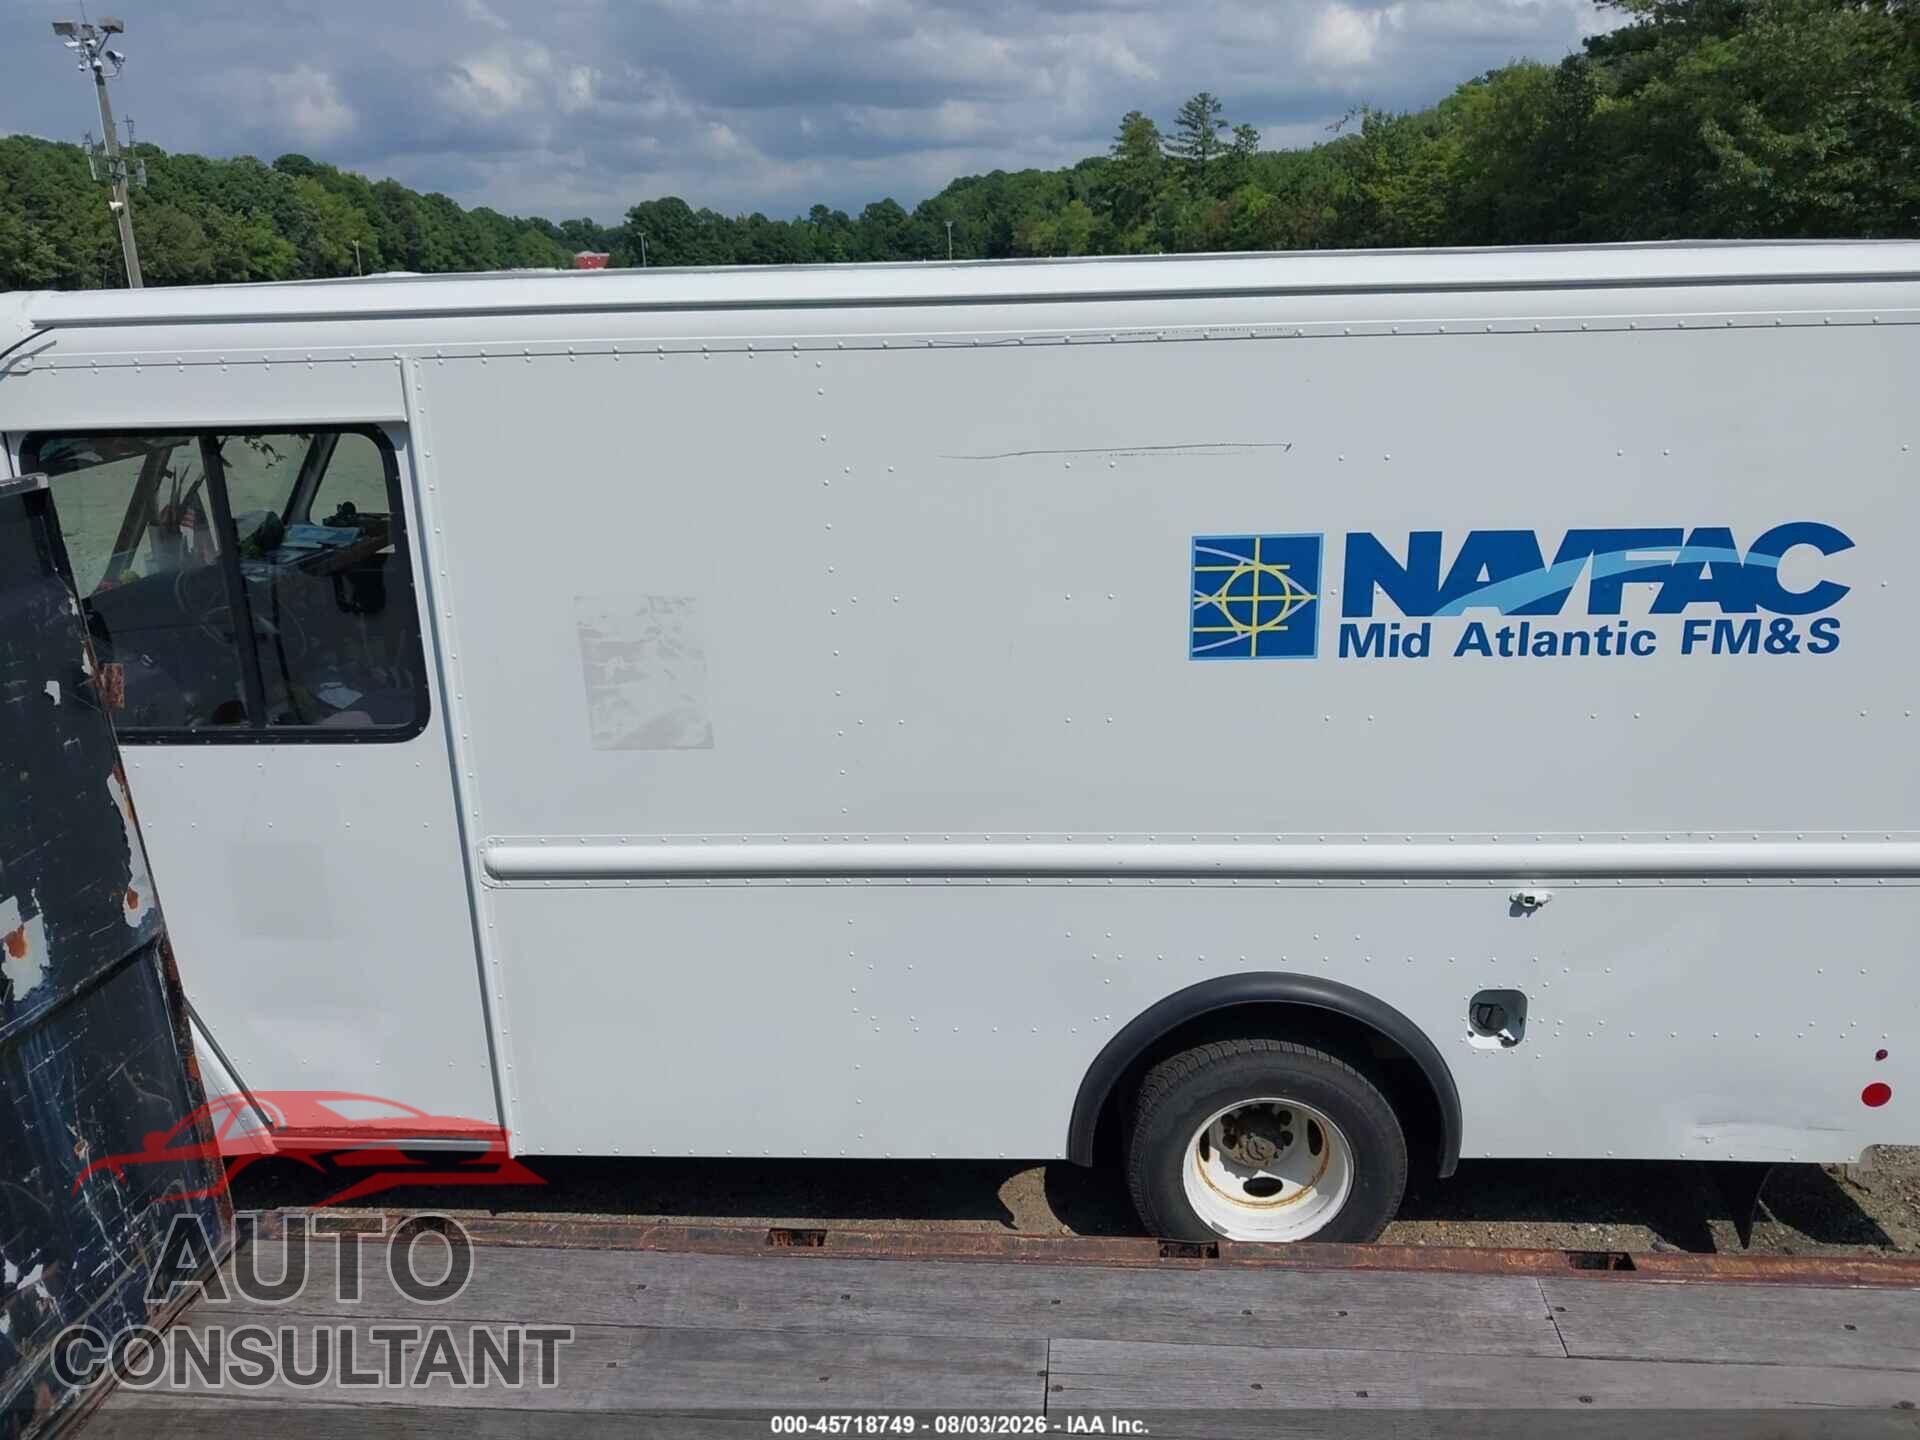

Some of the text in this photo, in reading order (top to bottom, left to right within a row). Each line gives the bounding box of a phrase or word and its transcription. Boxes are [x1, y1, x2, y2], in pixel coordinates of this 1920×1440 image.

[1341, 521, 1856, 617] NAVFAC
[1338, 616, 1842, 658] Mid Atlantic FM&S
